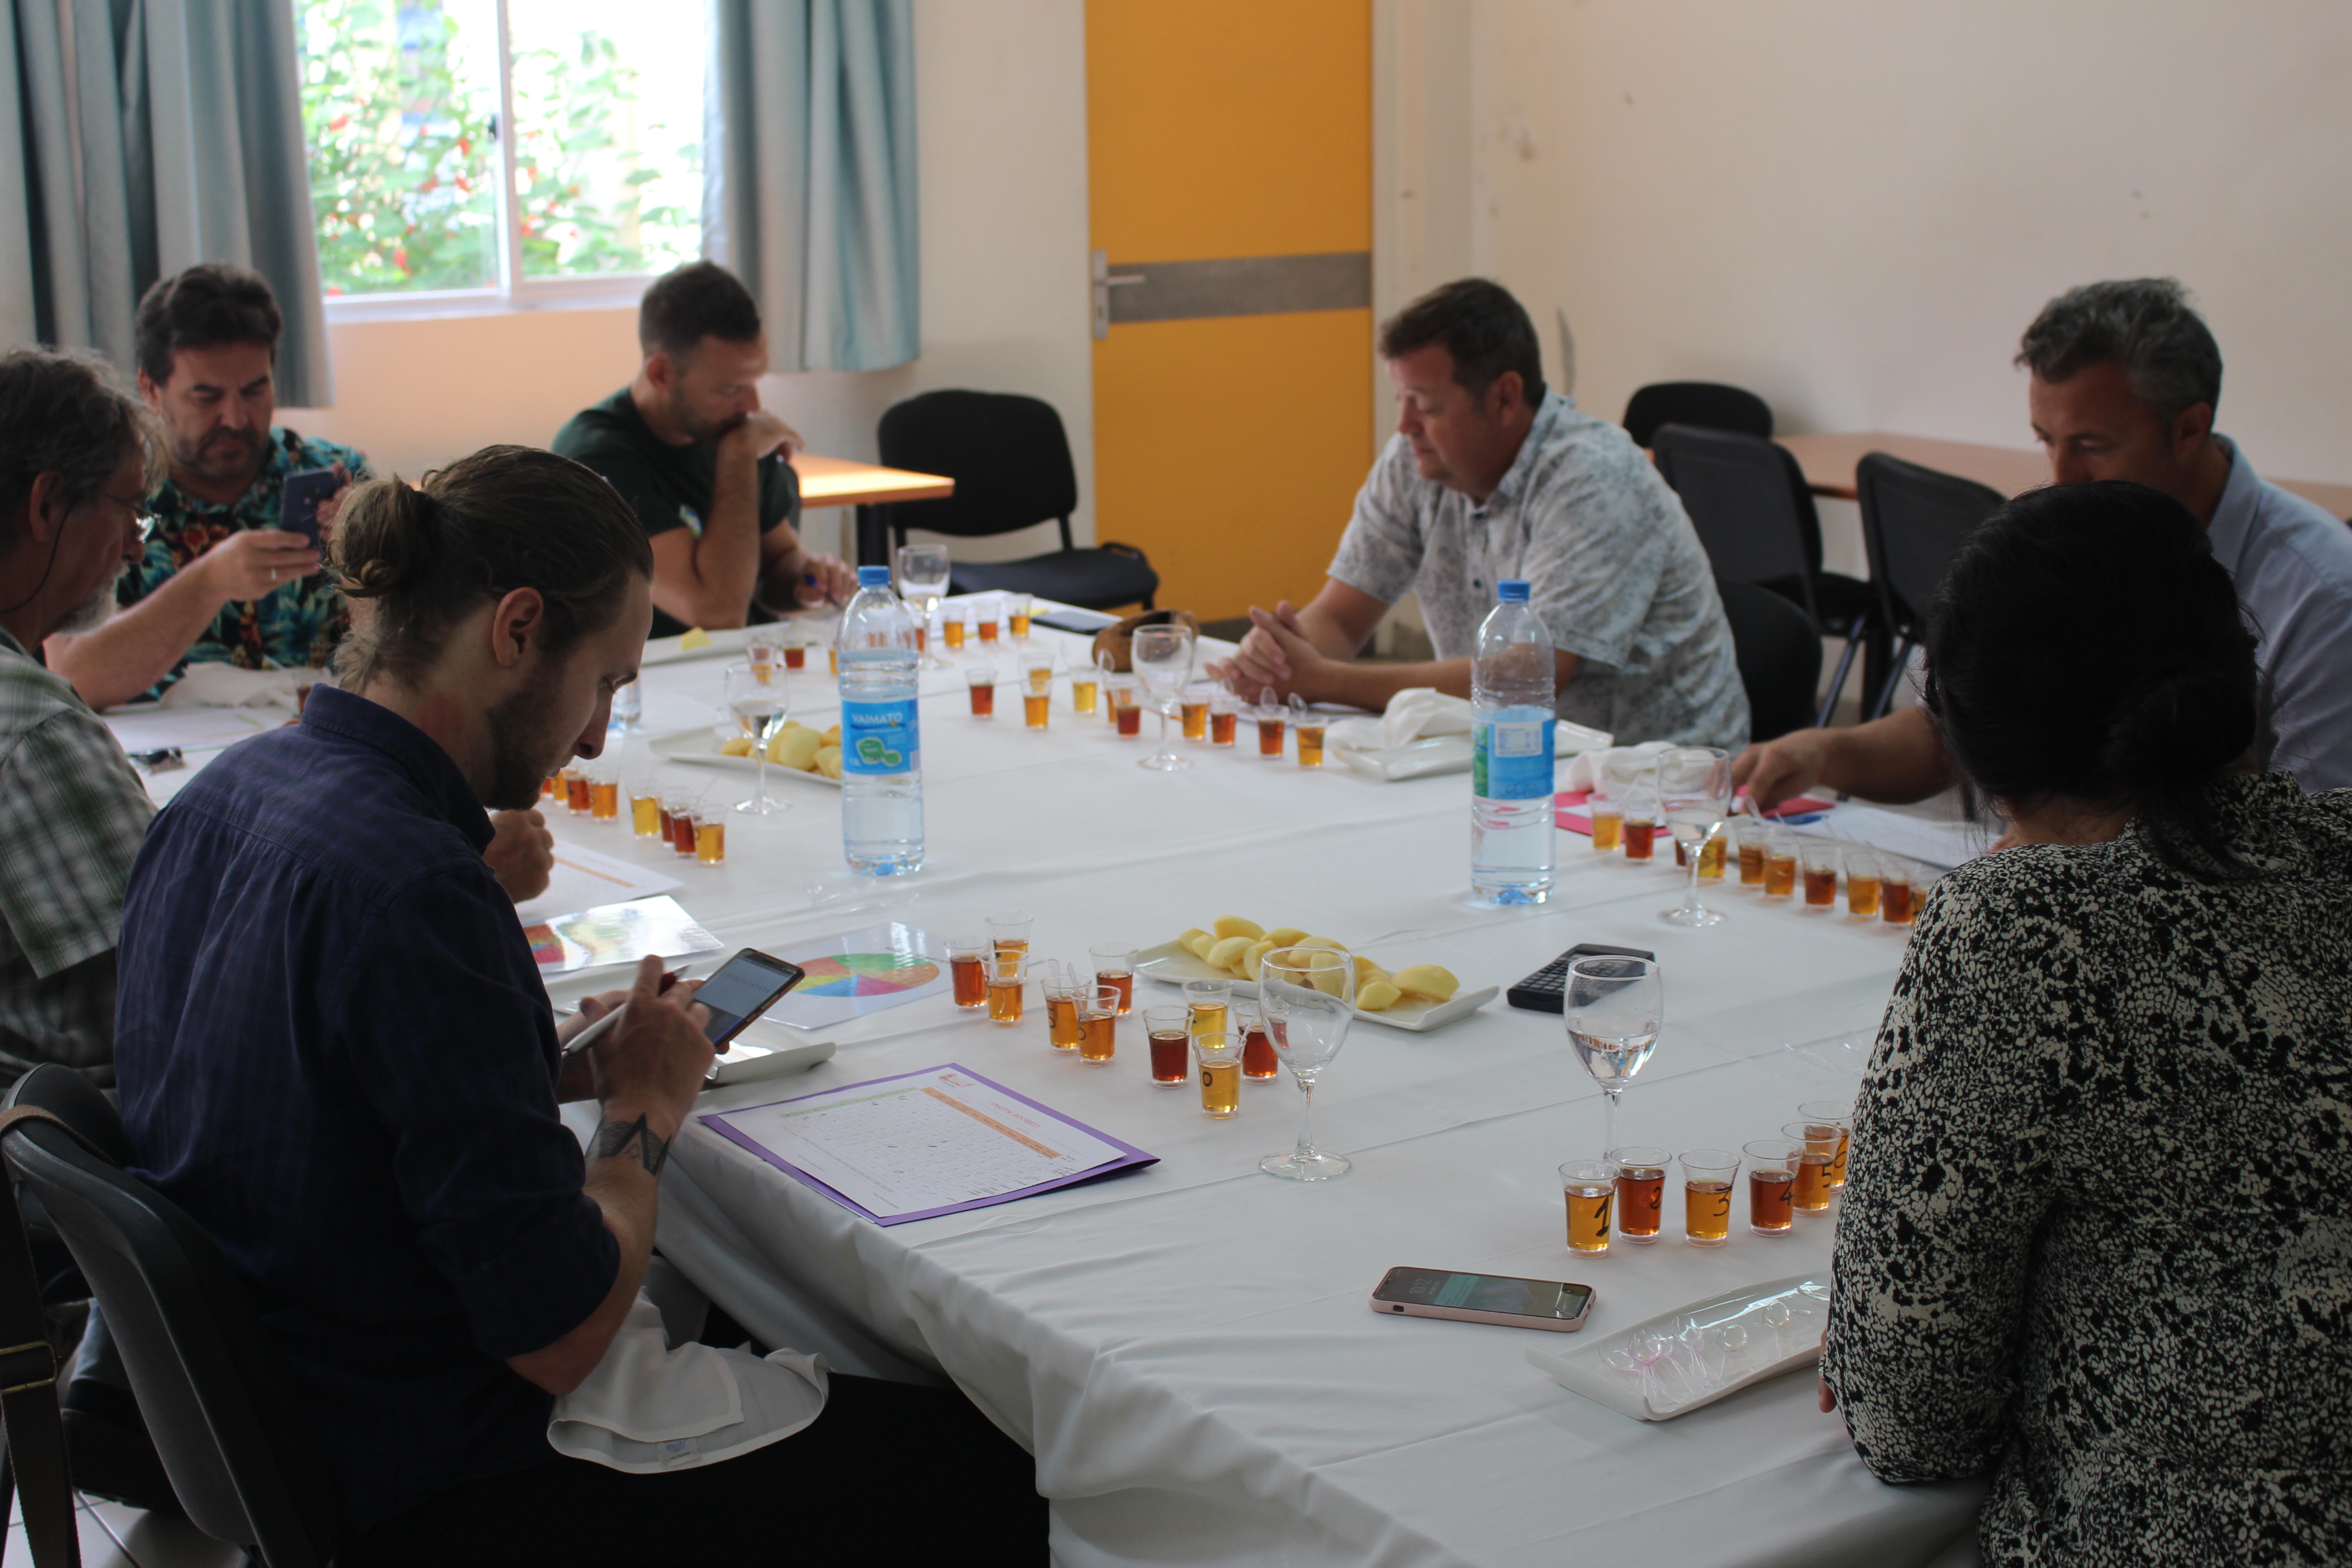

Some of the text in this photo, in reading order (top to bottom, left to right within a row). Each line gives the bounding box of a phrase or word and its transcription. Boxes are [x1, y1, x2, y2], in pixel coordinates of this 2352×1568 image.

[851, 712, 903, 724] VAIMATO
[1821, 1162, 1834, 1188] 5
[1650, 1186, 1662, 1210] 2
[1713, 1186, 1733, 1217] 3
[1779, 1177, 1797, 1206] 4
[1594, 1196, 1610, 1237] 1
